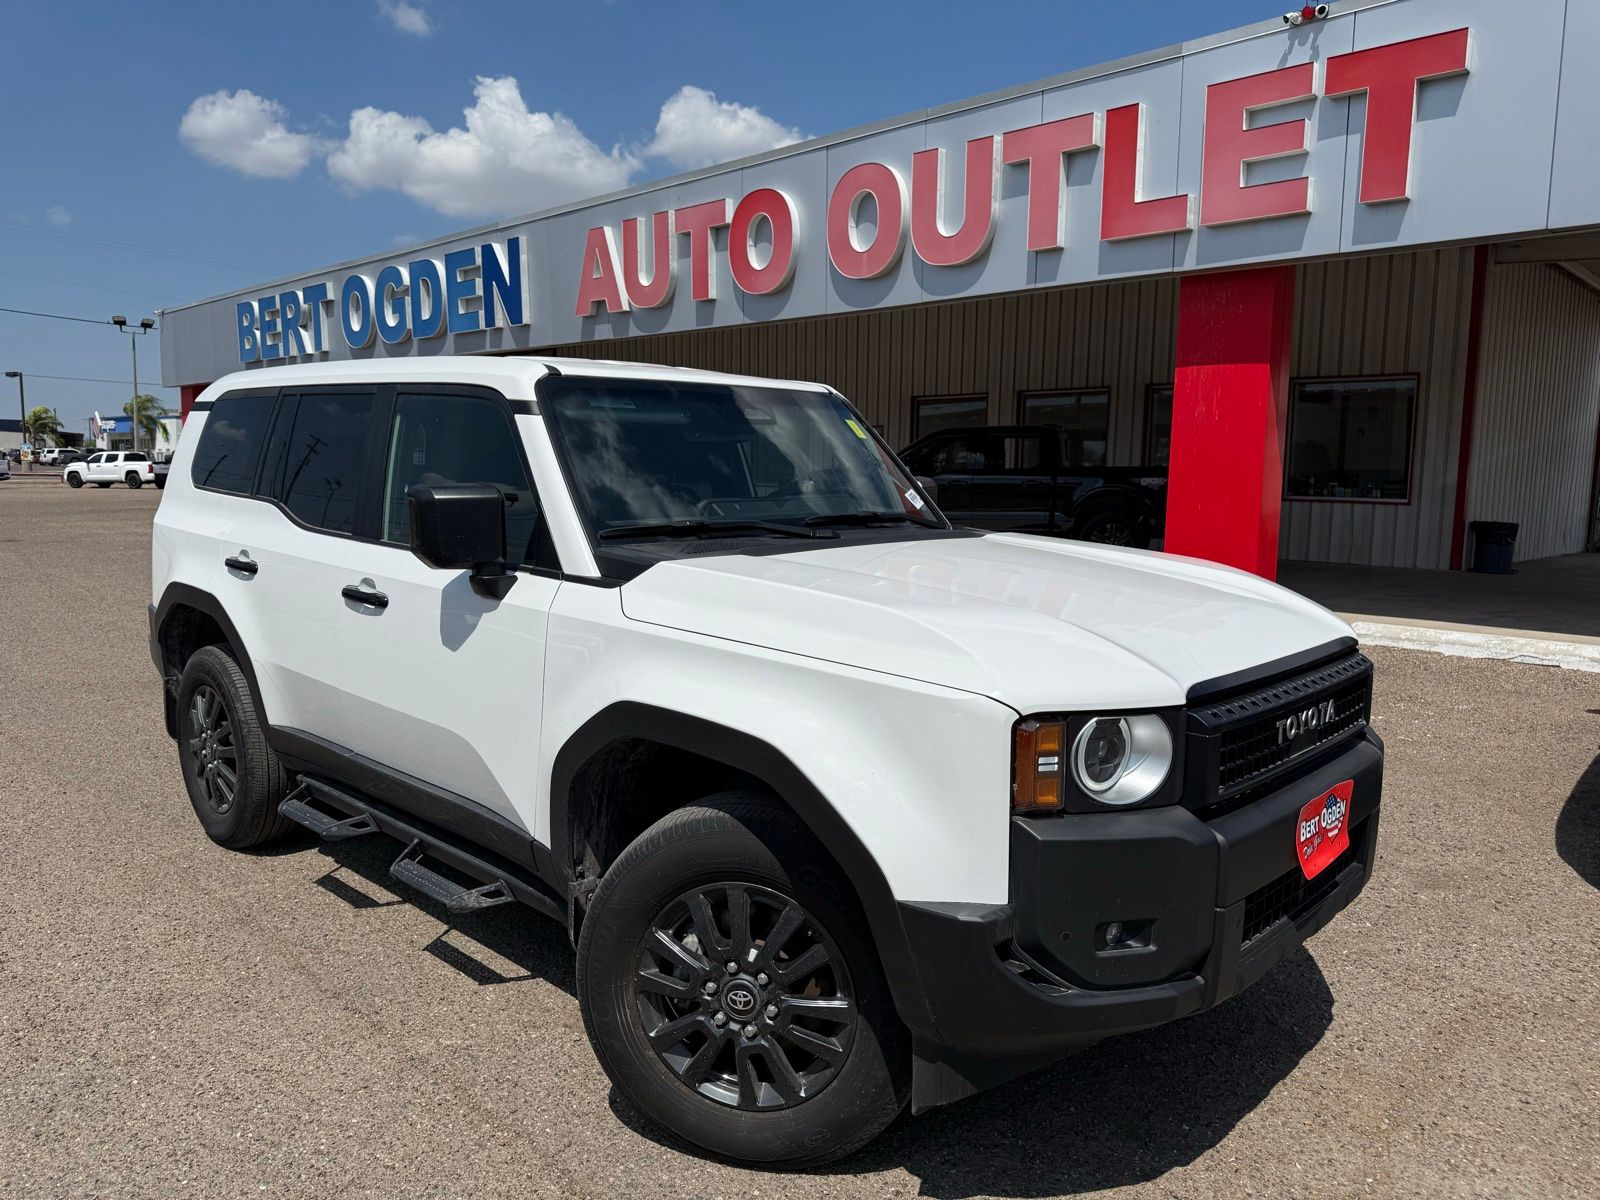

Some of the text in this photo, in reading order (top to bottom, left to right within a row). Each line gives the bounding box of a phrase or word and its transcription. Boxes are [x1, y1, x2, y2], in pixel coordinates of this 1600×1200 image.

[236, 27, 1472, 363] BERT OGDEN AUTO OUTLET
[1276, 698, 1336, 745] TOYOTA
[1300, 799, 1347, 843] BERT OGDEN
